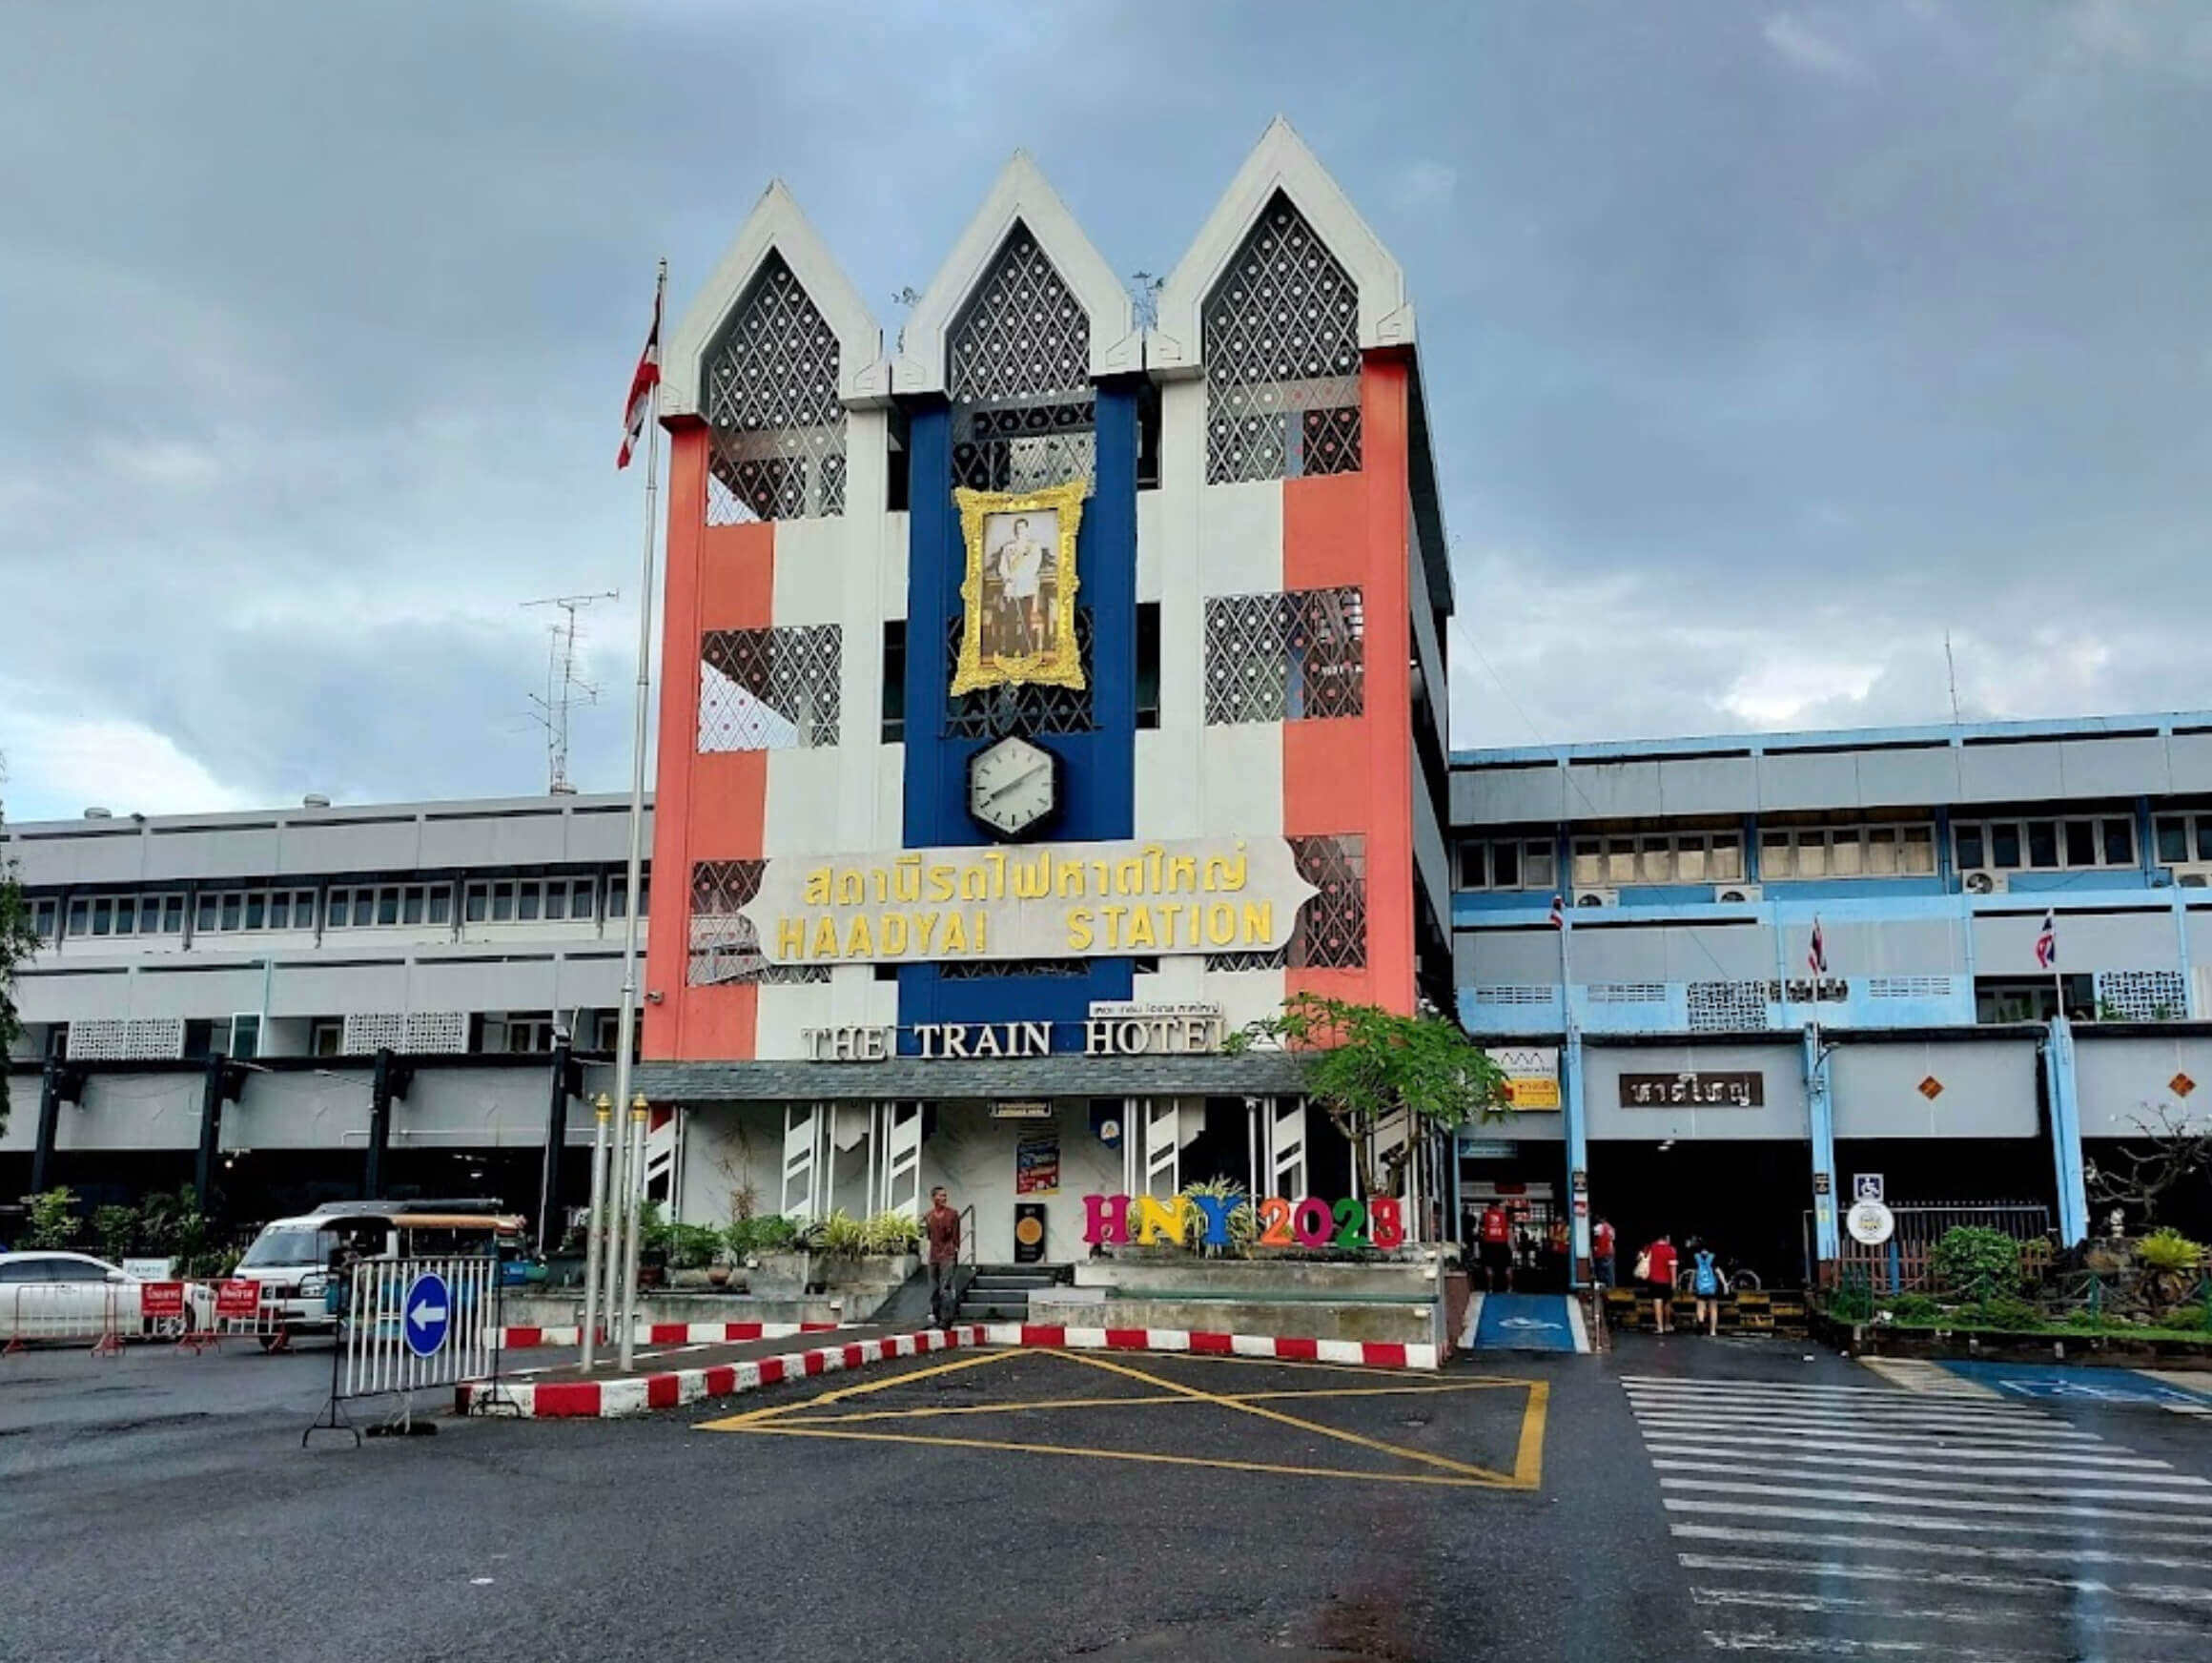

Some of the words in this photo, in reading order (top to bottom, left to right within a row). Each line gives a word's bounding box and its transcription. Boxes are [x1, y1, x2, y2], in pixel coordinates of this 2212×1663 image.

[804, 842, 1248, 907] สถานีรถไฟหาดใหญ่
[777, 909, 987, 960] HAADYAI
[1066, 900, 1273, 951] STATION
[802, 1026, 888, 1061] THE
[914, 1020, 1054, 1059] TRAIN
[1084, 1017, 1226, 1054] HOTEL
[1630, 1073, 1751, 1106] หาดใหญ่
[1082, 1194, 1243, 1244] HNY
[1258, 1196, 1405, 1252] 2023
